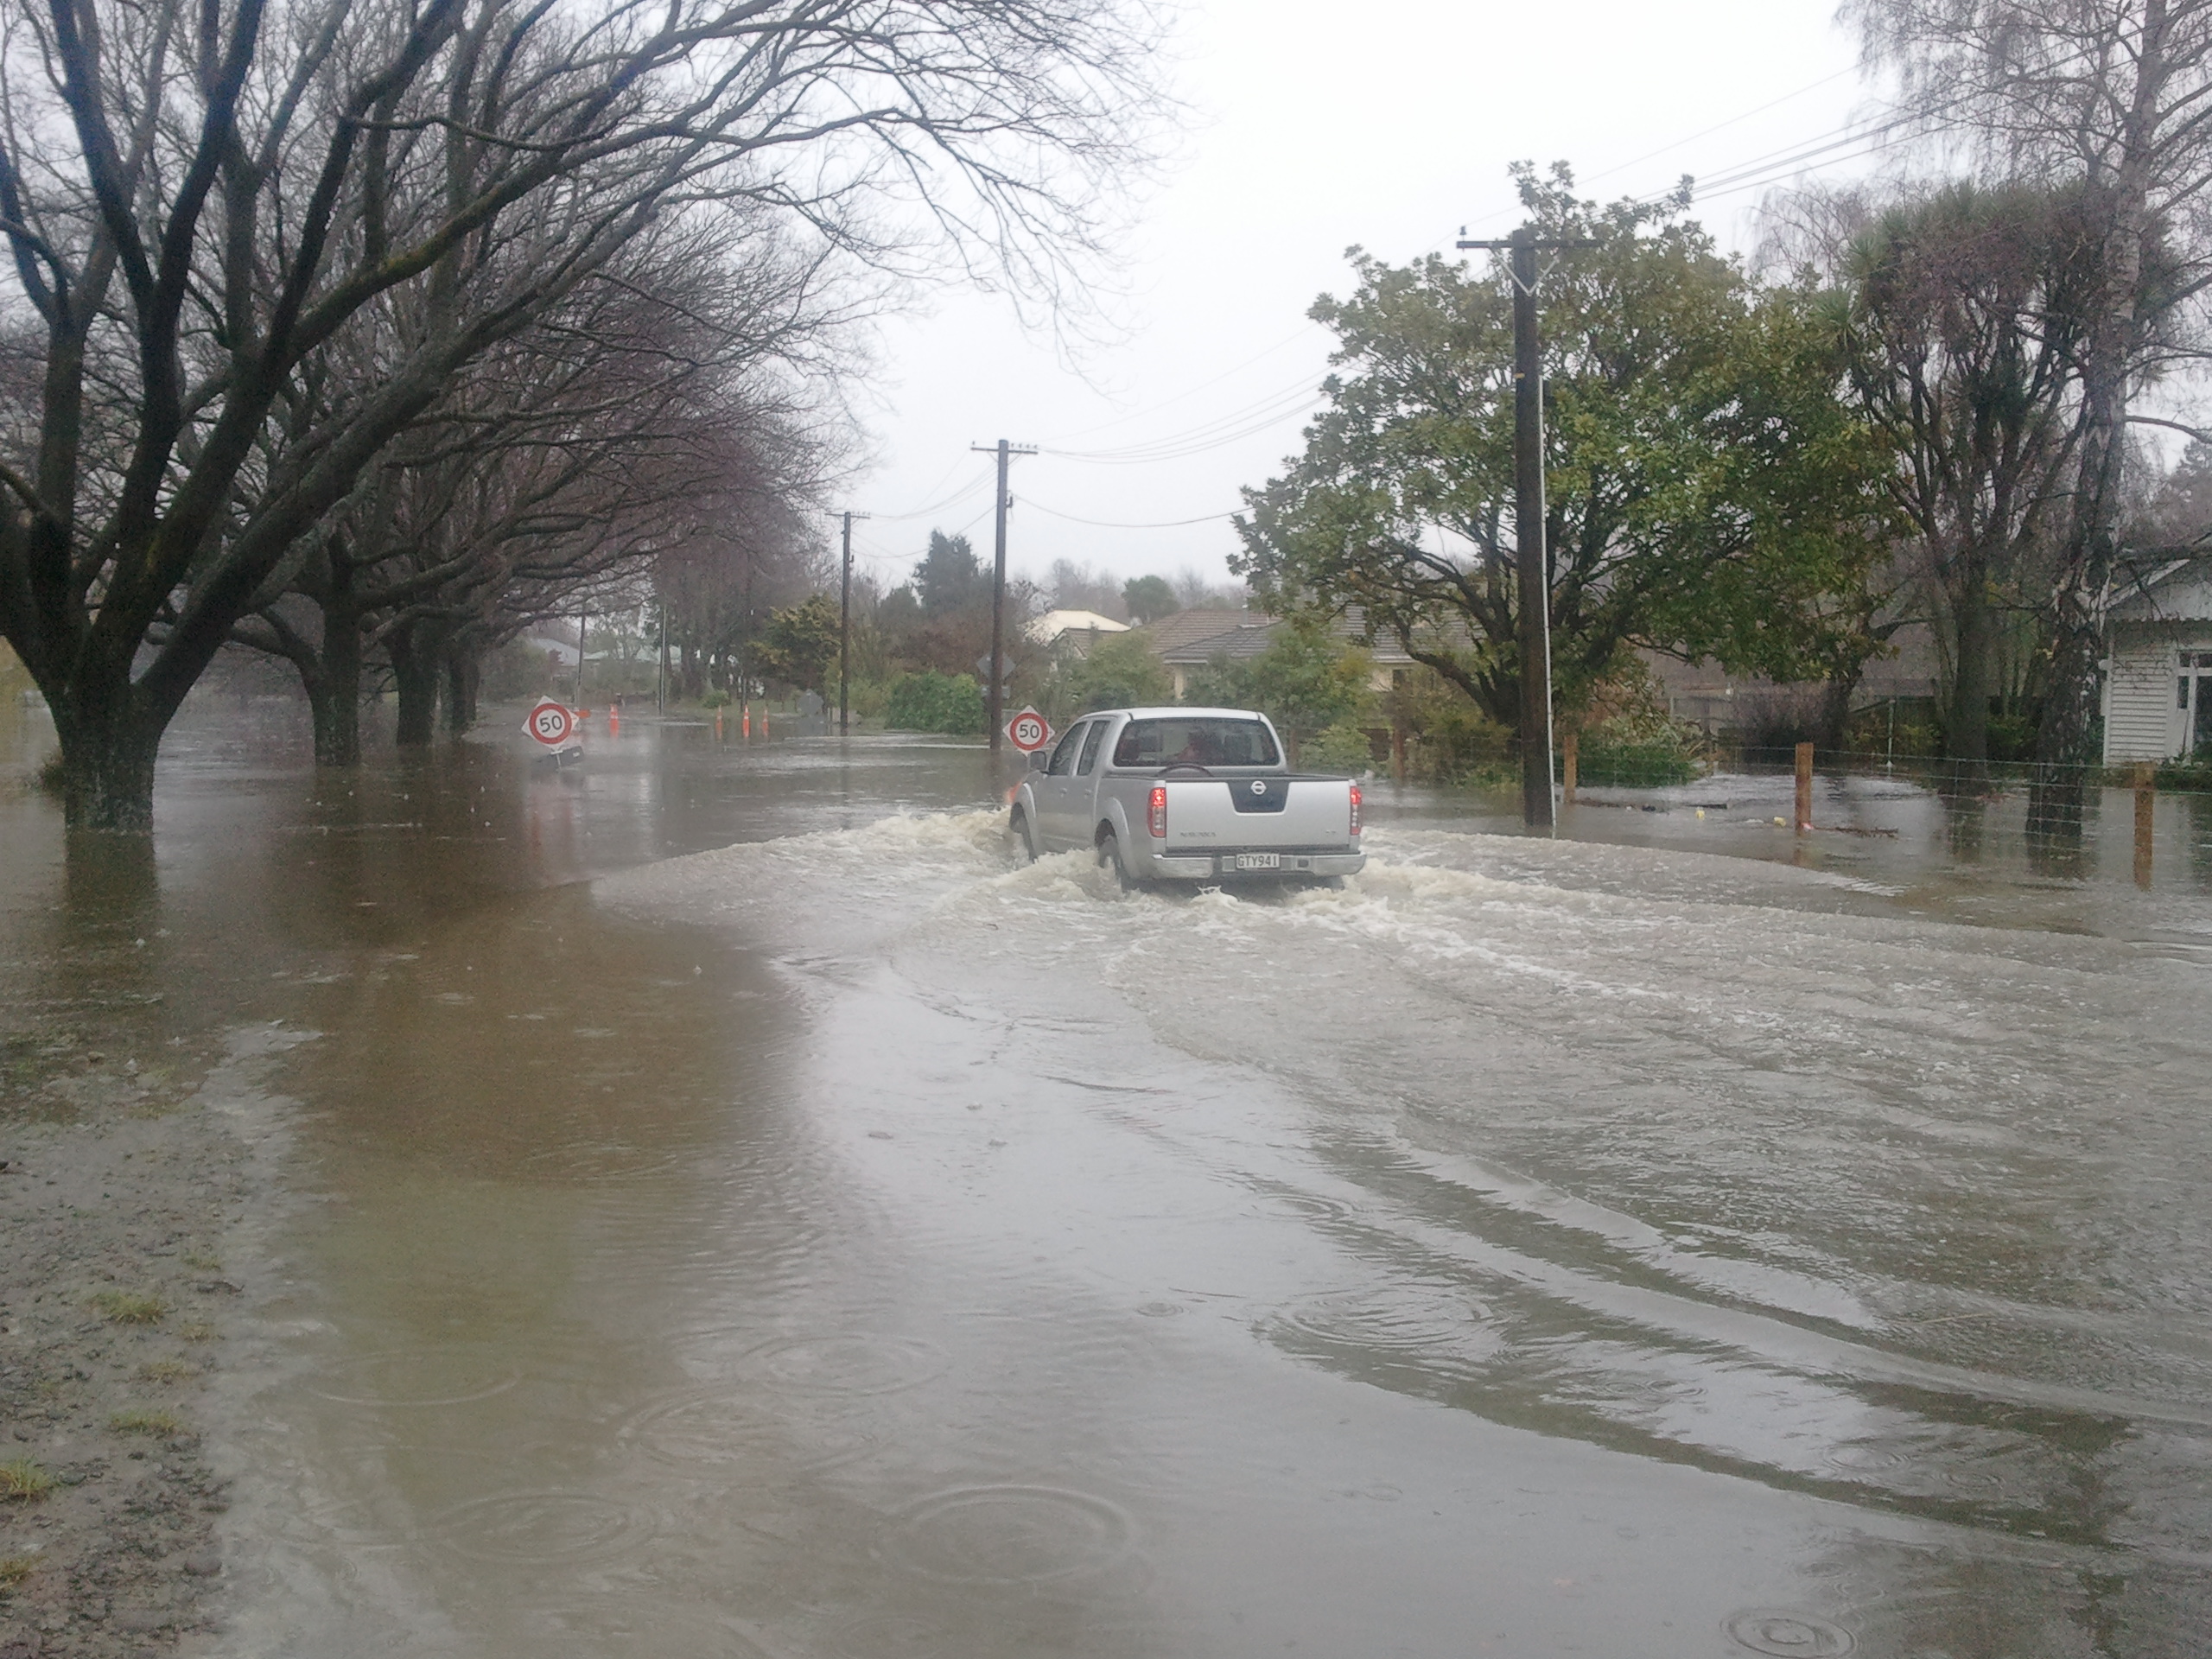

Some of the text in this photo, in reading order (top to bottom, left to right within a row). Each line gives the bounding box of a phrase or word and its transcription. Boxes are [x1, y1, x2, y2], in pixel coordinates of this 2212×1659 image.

[539, 715, 563, 733] 50
[1020, 724, 1039, 738] 50
[1237, 855, 1277, 867] GTY941
